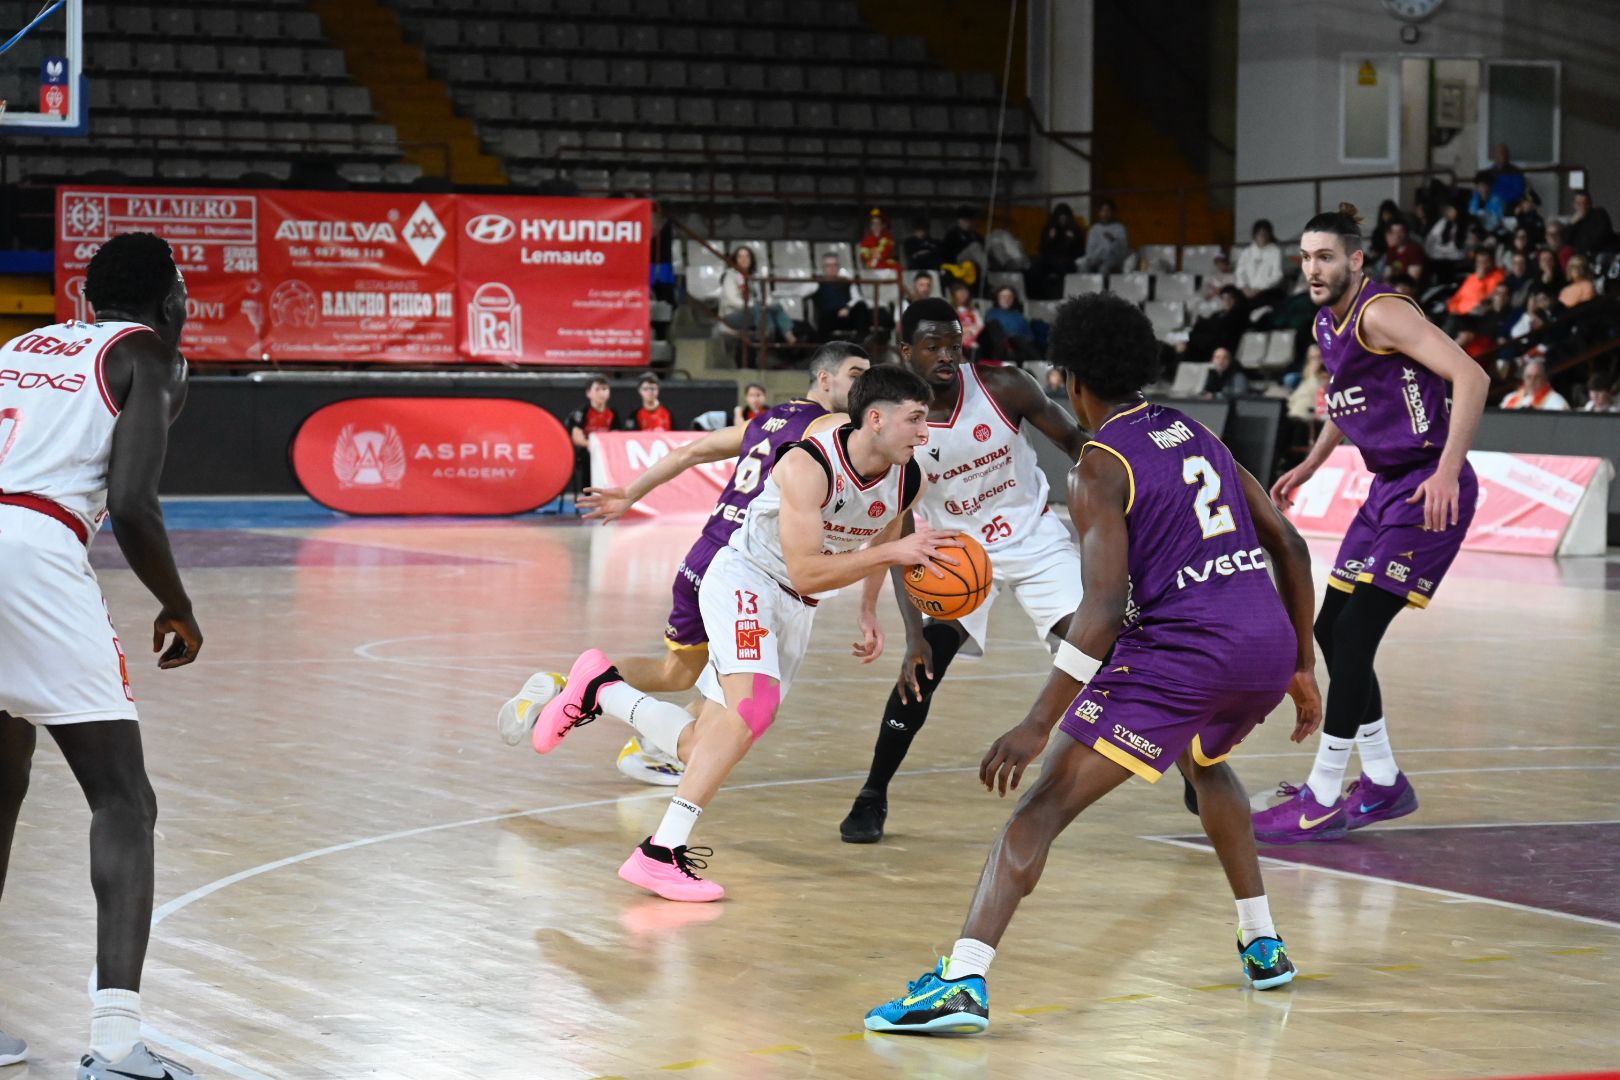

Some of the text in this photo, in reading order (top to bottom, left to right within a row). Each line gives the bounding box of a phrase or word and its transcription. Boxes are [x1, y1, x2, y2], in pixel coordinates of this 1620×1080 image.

[127, 198, 236, 218] PALMERO
[275, 219, 398, 243] ATILVA
[521, 219, 642, 243] HYUNDAI
[521, 247, 606, 266] Lemauto
[322, 291, 386, 317] RANCHO
[389, 292, 433, 317] CHICO
[479, 311, 511, 351] R3
[12, 334, 93, 357] DENG
[1407, 383, 1429, 434] aspasia
[415, 440, 535, 462] ASPIRE
[943, 444, 1010, 480] CAJA RURAL
[433, 467, 517, 479] ACADEMY
[734, 438, 771, 494] 6
[1182, 455, 1237, 540] 2
[823, 520, 846, 533] AJA
[981, 515, 1013, 544] 25
[1386, 560, 1411, 579] CBC
[734, 589, 759, 615] 13
[737, 620, 757, 631] BUN
[738, 648, 758, 659] HAM
[1077, 699, 1104, 720] CBC
